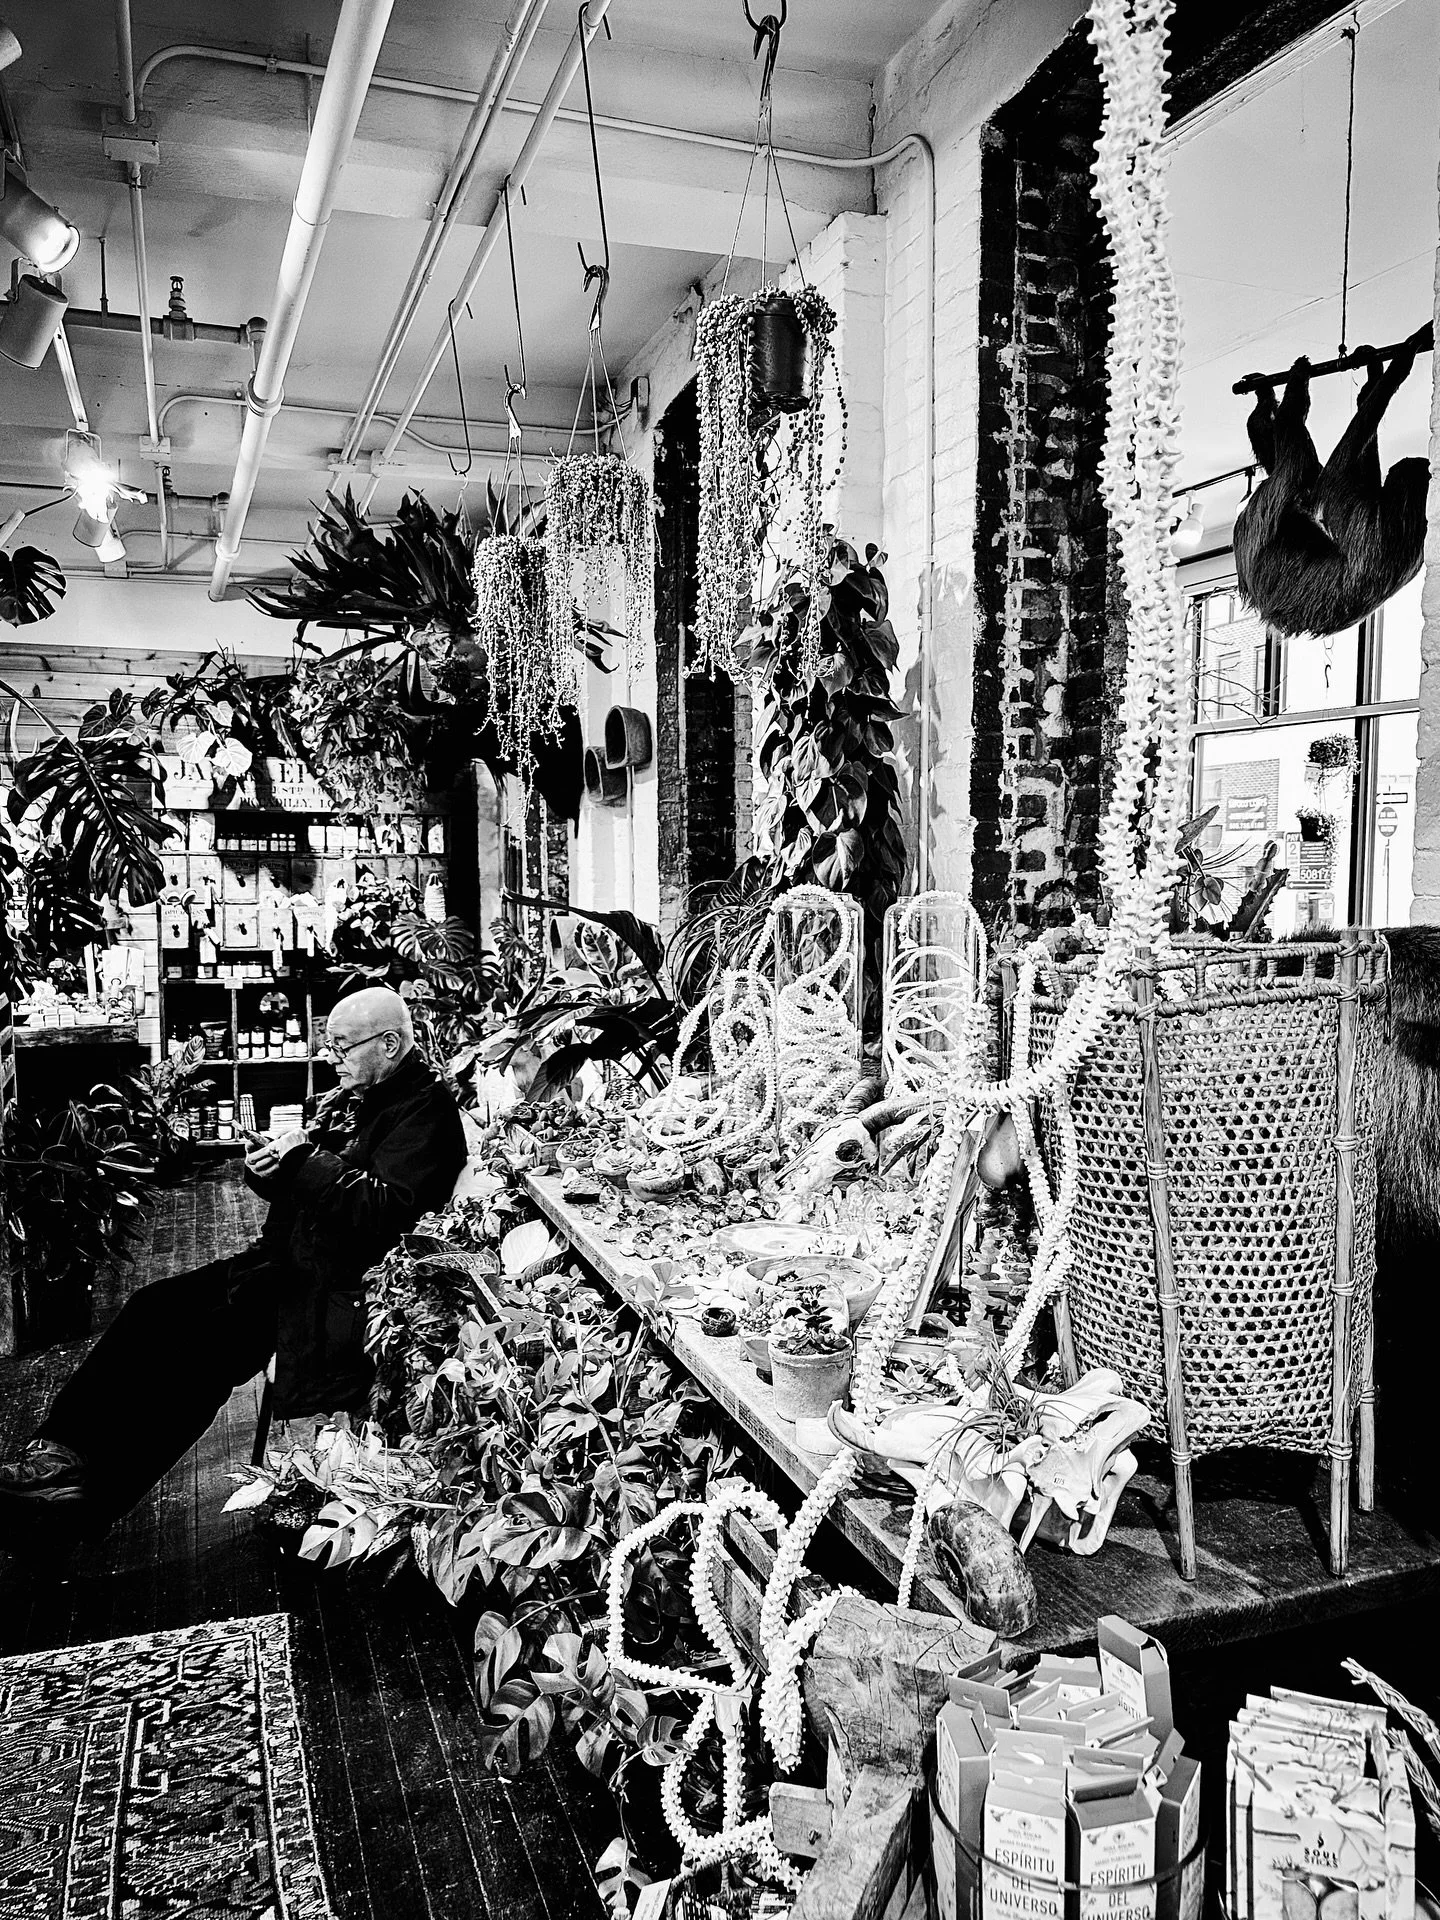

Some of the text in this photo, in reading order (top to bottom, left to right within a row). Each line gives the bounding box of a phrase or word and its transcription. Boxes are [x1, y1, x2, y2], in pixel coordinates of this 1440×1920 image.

[1286, 833, 1300, 843] PAY
[1289, 843, 1297, 856] 2
[1300, 869, 1329, 880] 50817
[994, 1846, 1055, 1874] ESPÍRITU
[1303, 1847, 1338, 1861] SOUL
[1303, 1856, 1339, 1868] STICKS
[1090, 1862, 1146, 1887] ESPÍRITU
[1011, 1875, 1034, 1894] DEL
[989, 1887, 1058, 1917] UNIVERSO
[1108, 1890, 1130, 1908] DEL
